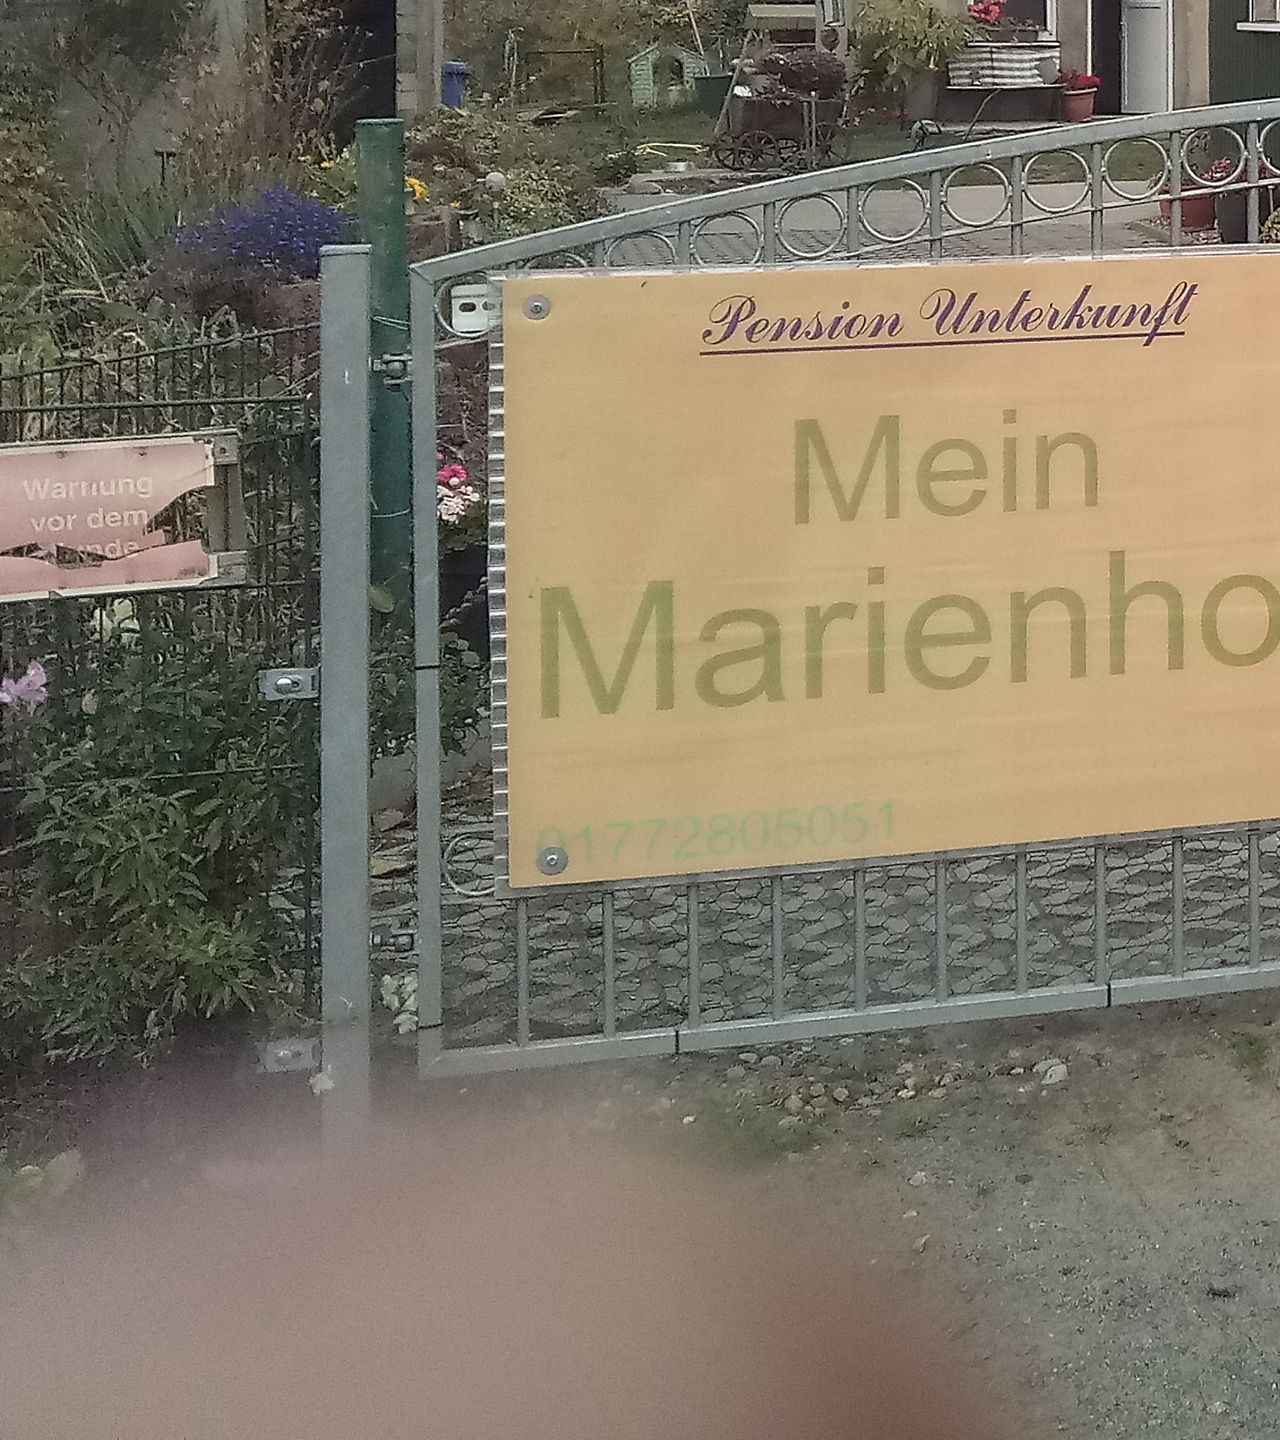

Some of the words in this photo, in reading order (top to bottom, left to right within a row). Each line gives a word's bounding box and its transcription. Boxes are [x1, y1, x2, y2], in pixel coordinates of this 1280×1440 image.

[702, 294, 904, 345] Pension
[919, 282, 1199, 347] Unterkunft
[22, 476, 153, 500] Warnung
[792, 408, 1100, 525] Mein
[30, 513, 77, 532] vor
[86, 507, 149, 529] dem
